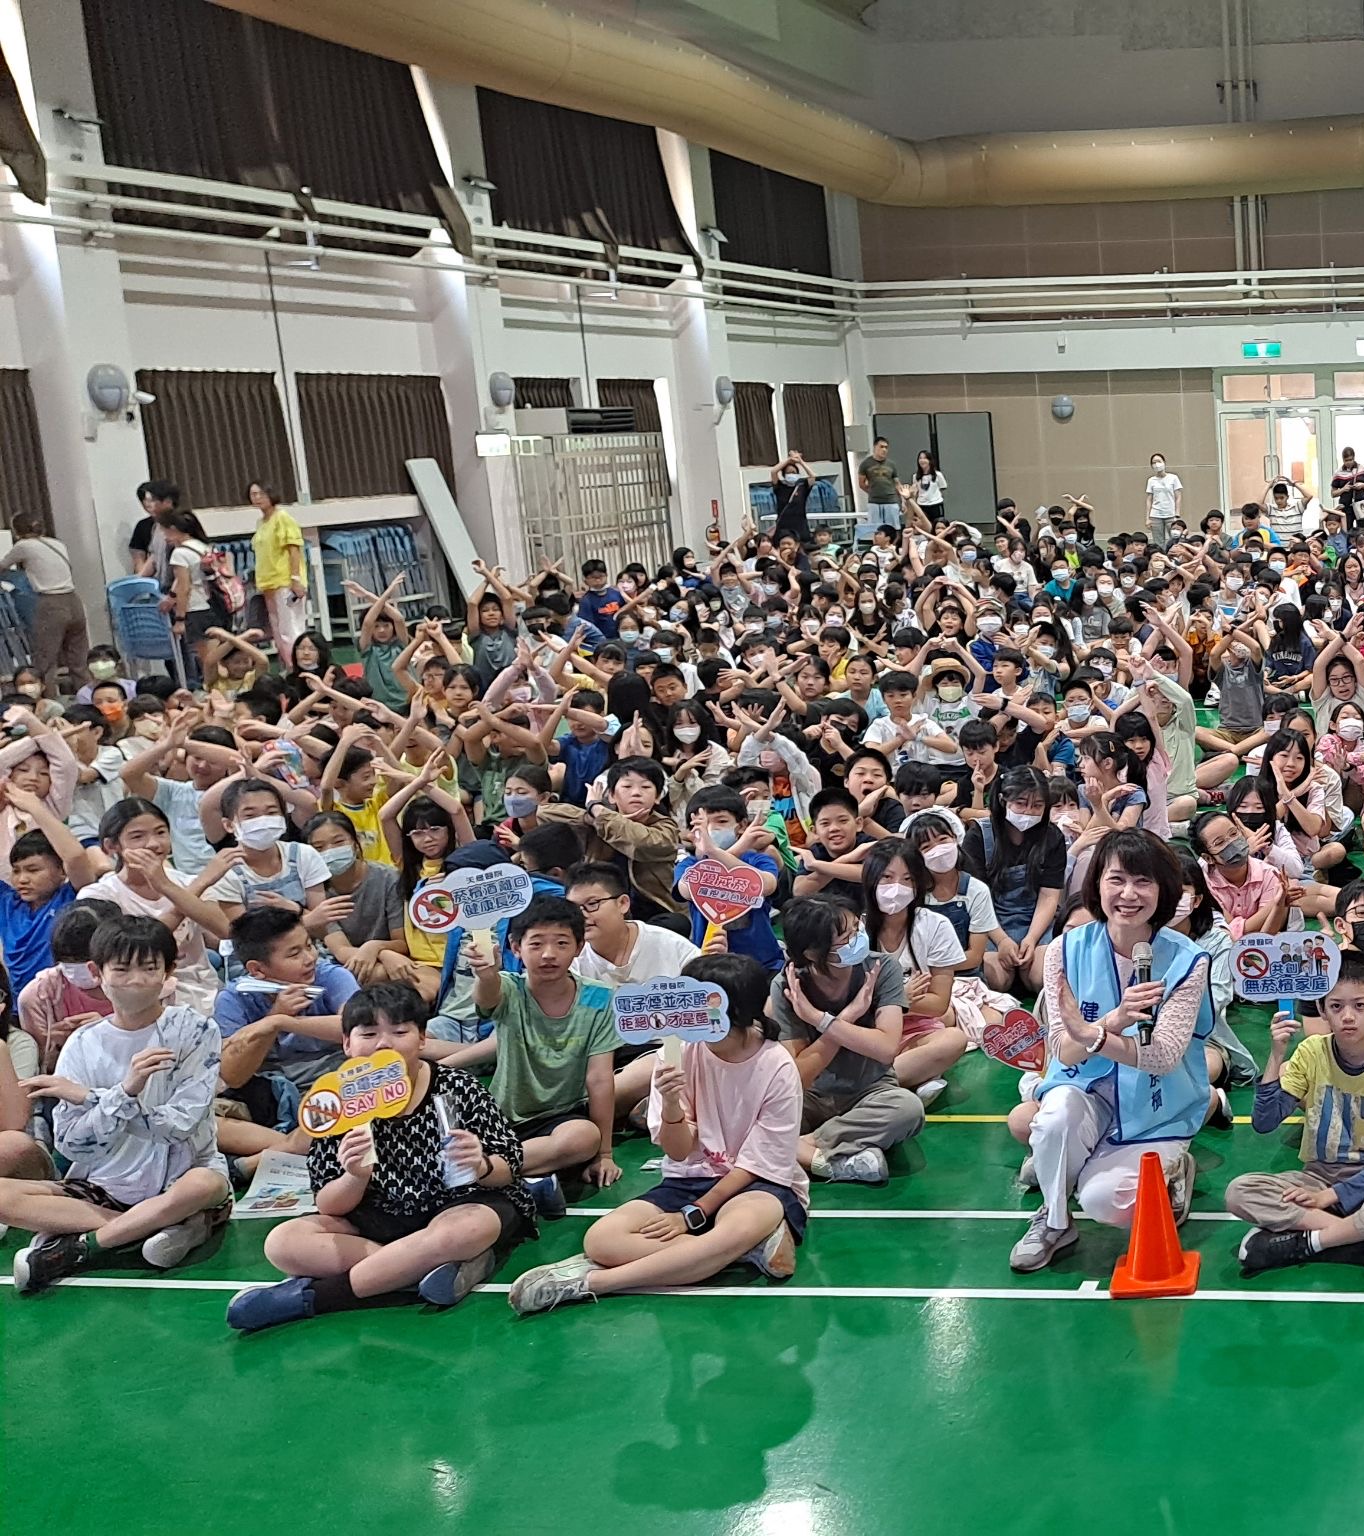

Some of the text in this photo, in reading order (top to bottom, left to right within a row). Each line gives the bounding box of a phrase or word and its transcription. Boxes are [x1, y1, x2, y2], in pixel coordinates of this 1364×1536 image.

[464, 892, 525, 916] 健康長久
[1271, 962, 1298, 975] 共創
[1244, 976, 1329, 994] 無菸檳家庭
[621, 1016, 648, 1031] 拒絕
[345, 1081, 405, 1117] SAY NO
